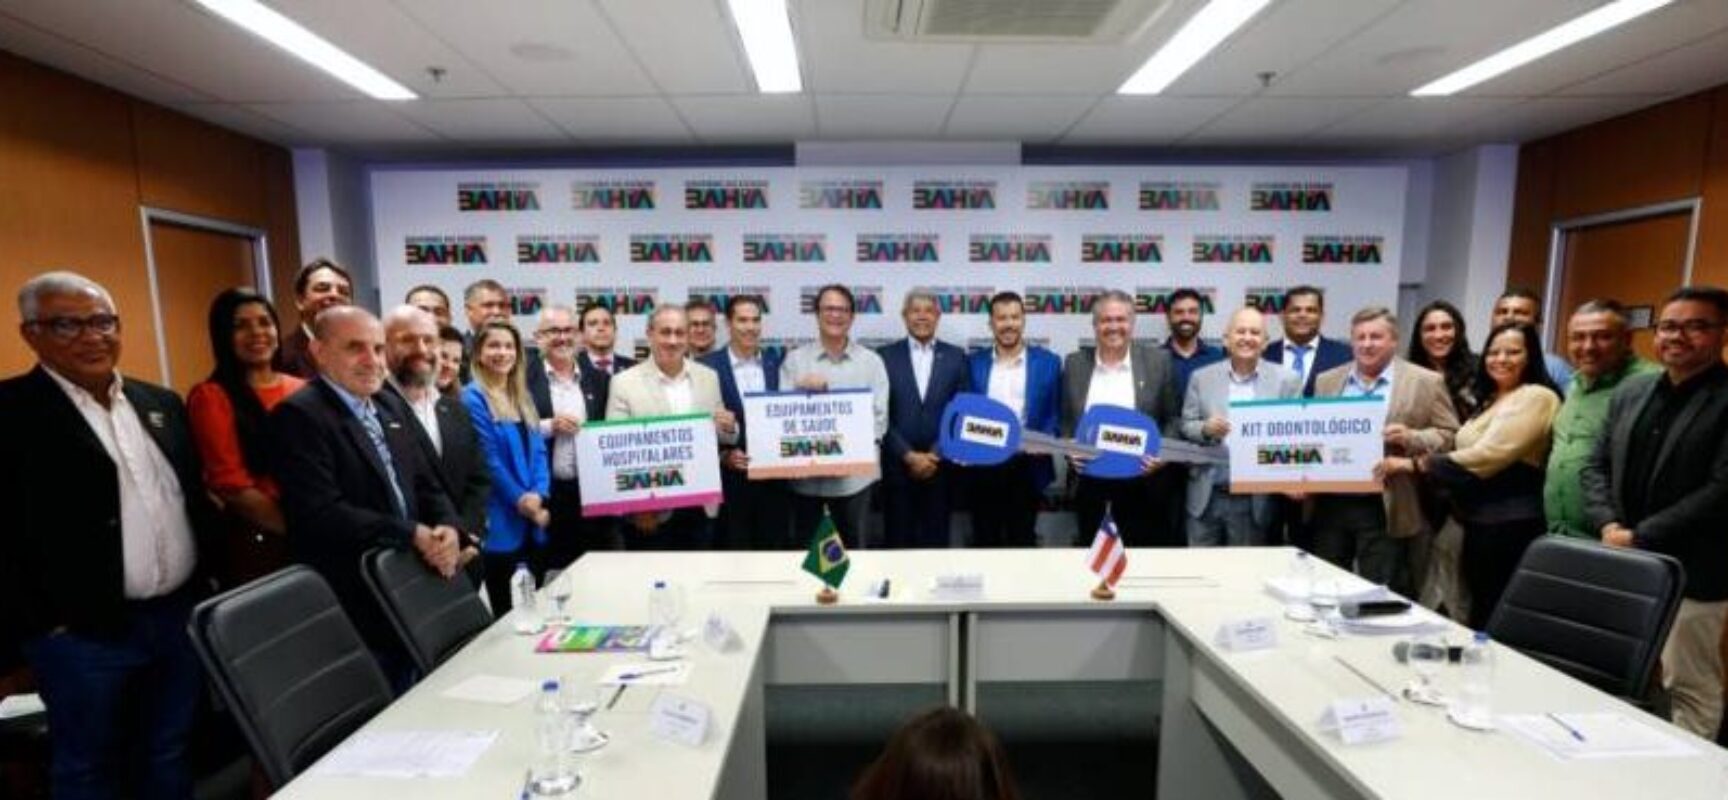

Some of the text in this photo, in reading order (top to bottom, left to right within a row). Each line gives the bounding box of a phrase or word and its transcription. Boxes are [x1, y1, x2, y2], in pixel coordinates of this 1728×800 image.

[458, 190, 541, 211] BAHIA
[573, 189, 655, 209] BAHIA
[685, 188, 768, 208] BAHIA
[800, 188, 882, 208] BAHIA
[913, 188, 995, 208] BAHIA
[1027, 189, 1108, 209] BAHIA
[1140, 190, 1219, 209] BAHIA
[1251, 190, 1331, 211] BAHIA
[406, 243, 487, 264] BAHIA
[518, 243, 600, 263] BAHIA
[631, 242, 713, 262] BAHIA
[743, 242, 826, 262] BAHIA
[857, 242, 939, 262] BAHIA
[969, 242, 1052, 262] BAHIA
[1082, 242, 1163, 262] BAHIA
[1192, 243, 1272, 263] BAHIA
[1302, 243, 1382, 263] BAHIA
[766, 401, 853, 417] EQUIPAMENTOS
[1242, 415, 1371, 436] KIT ODONTOLÓGICO
[598, 428, 693, 449] EQUIPAMENTOS
[602, 446, 693, 467] HOSPITALARES
[780, 441, 843, 457] BAHIA
[1257, 449, 1323, 464] BAHIA
[616, 469, 684, 491] BAHIA
